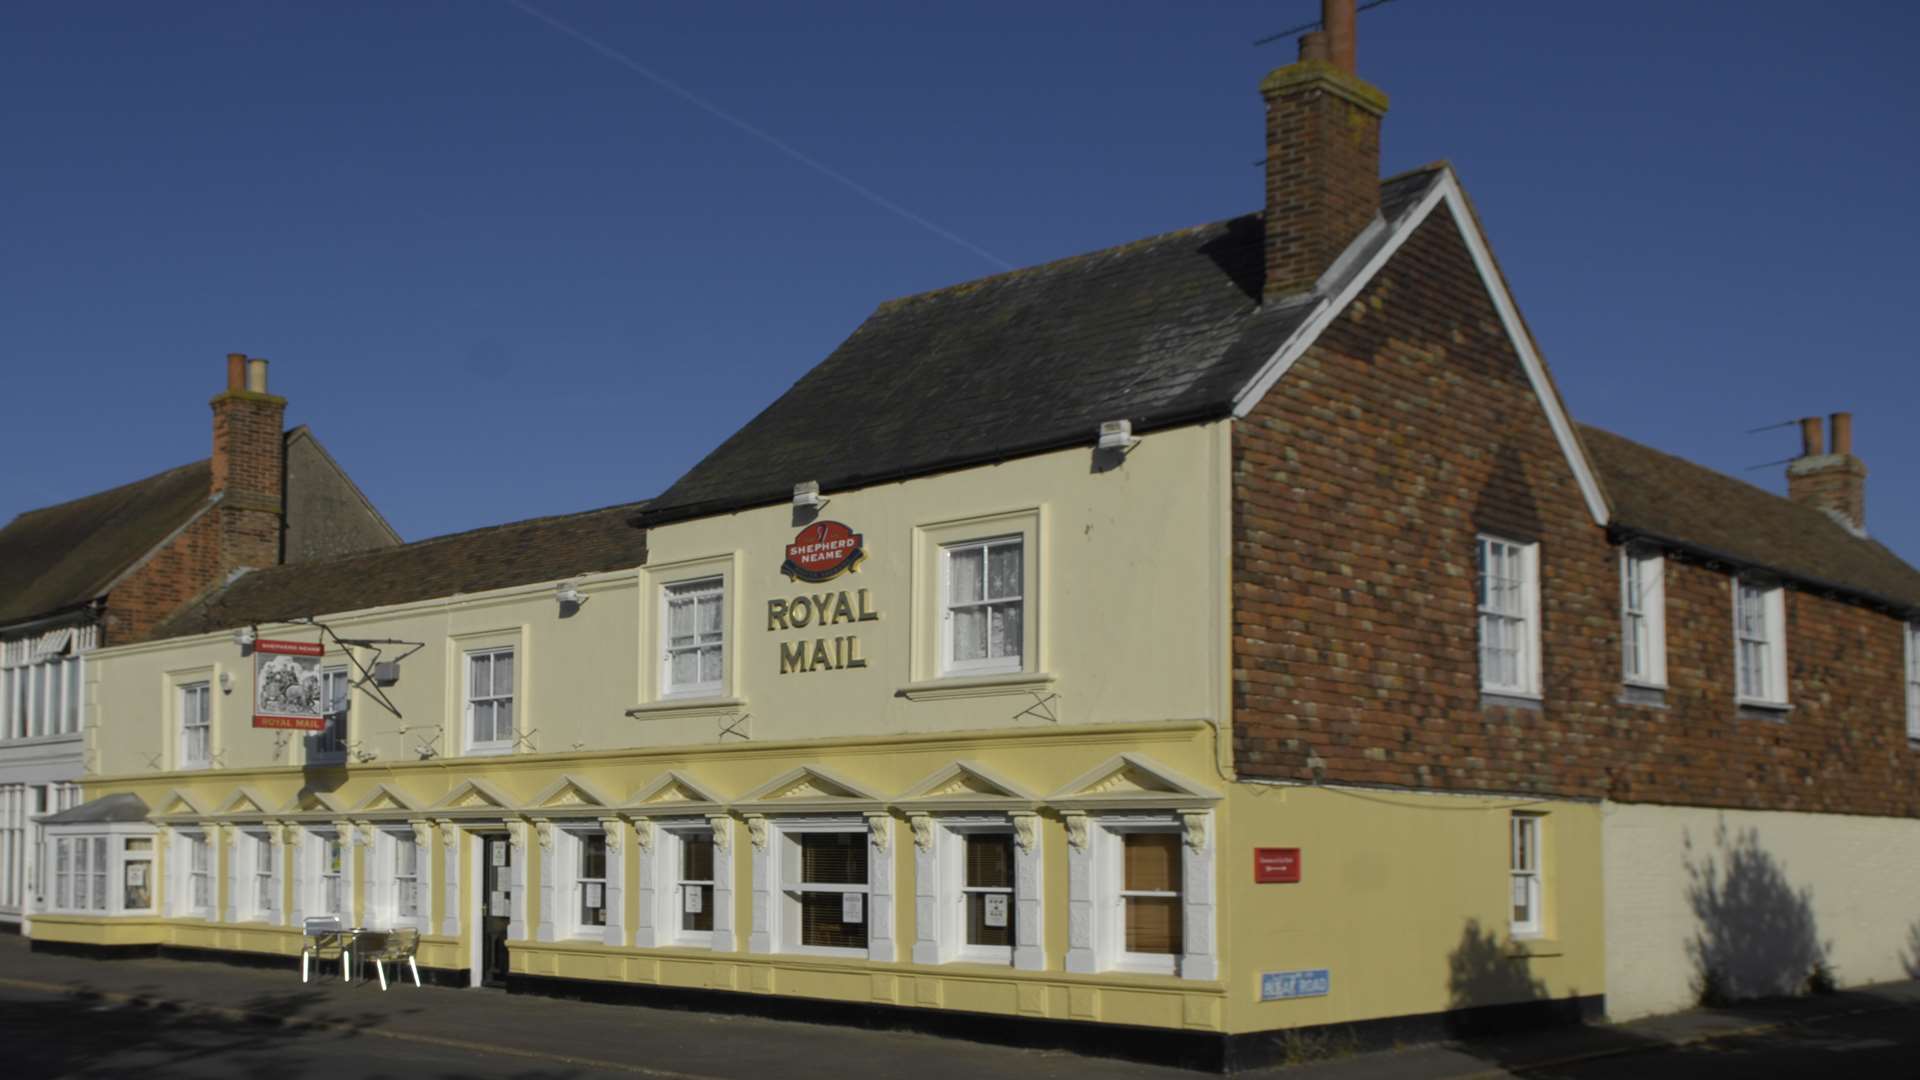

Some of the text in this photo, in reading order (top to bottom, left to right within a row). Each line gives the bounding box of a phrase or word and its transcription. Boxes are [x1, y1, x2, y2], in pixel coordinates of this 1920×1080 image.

[790, 538, 855, 556] SHEPHERD
[801, 550, 843, 563] NEAME
[767, 588, 879, 632] ROYAL
[779, 635, 867, 675] MAIL
